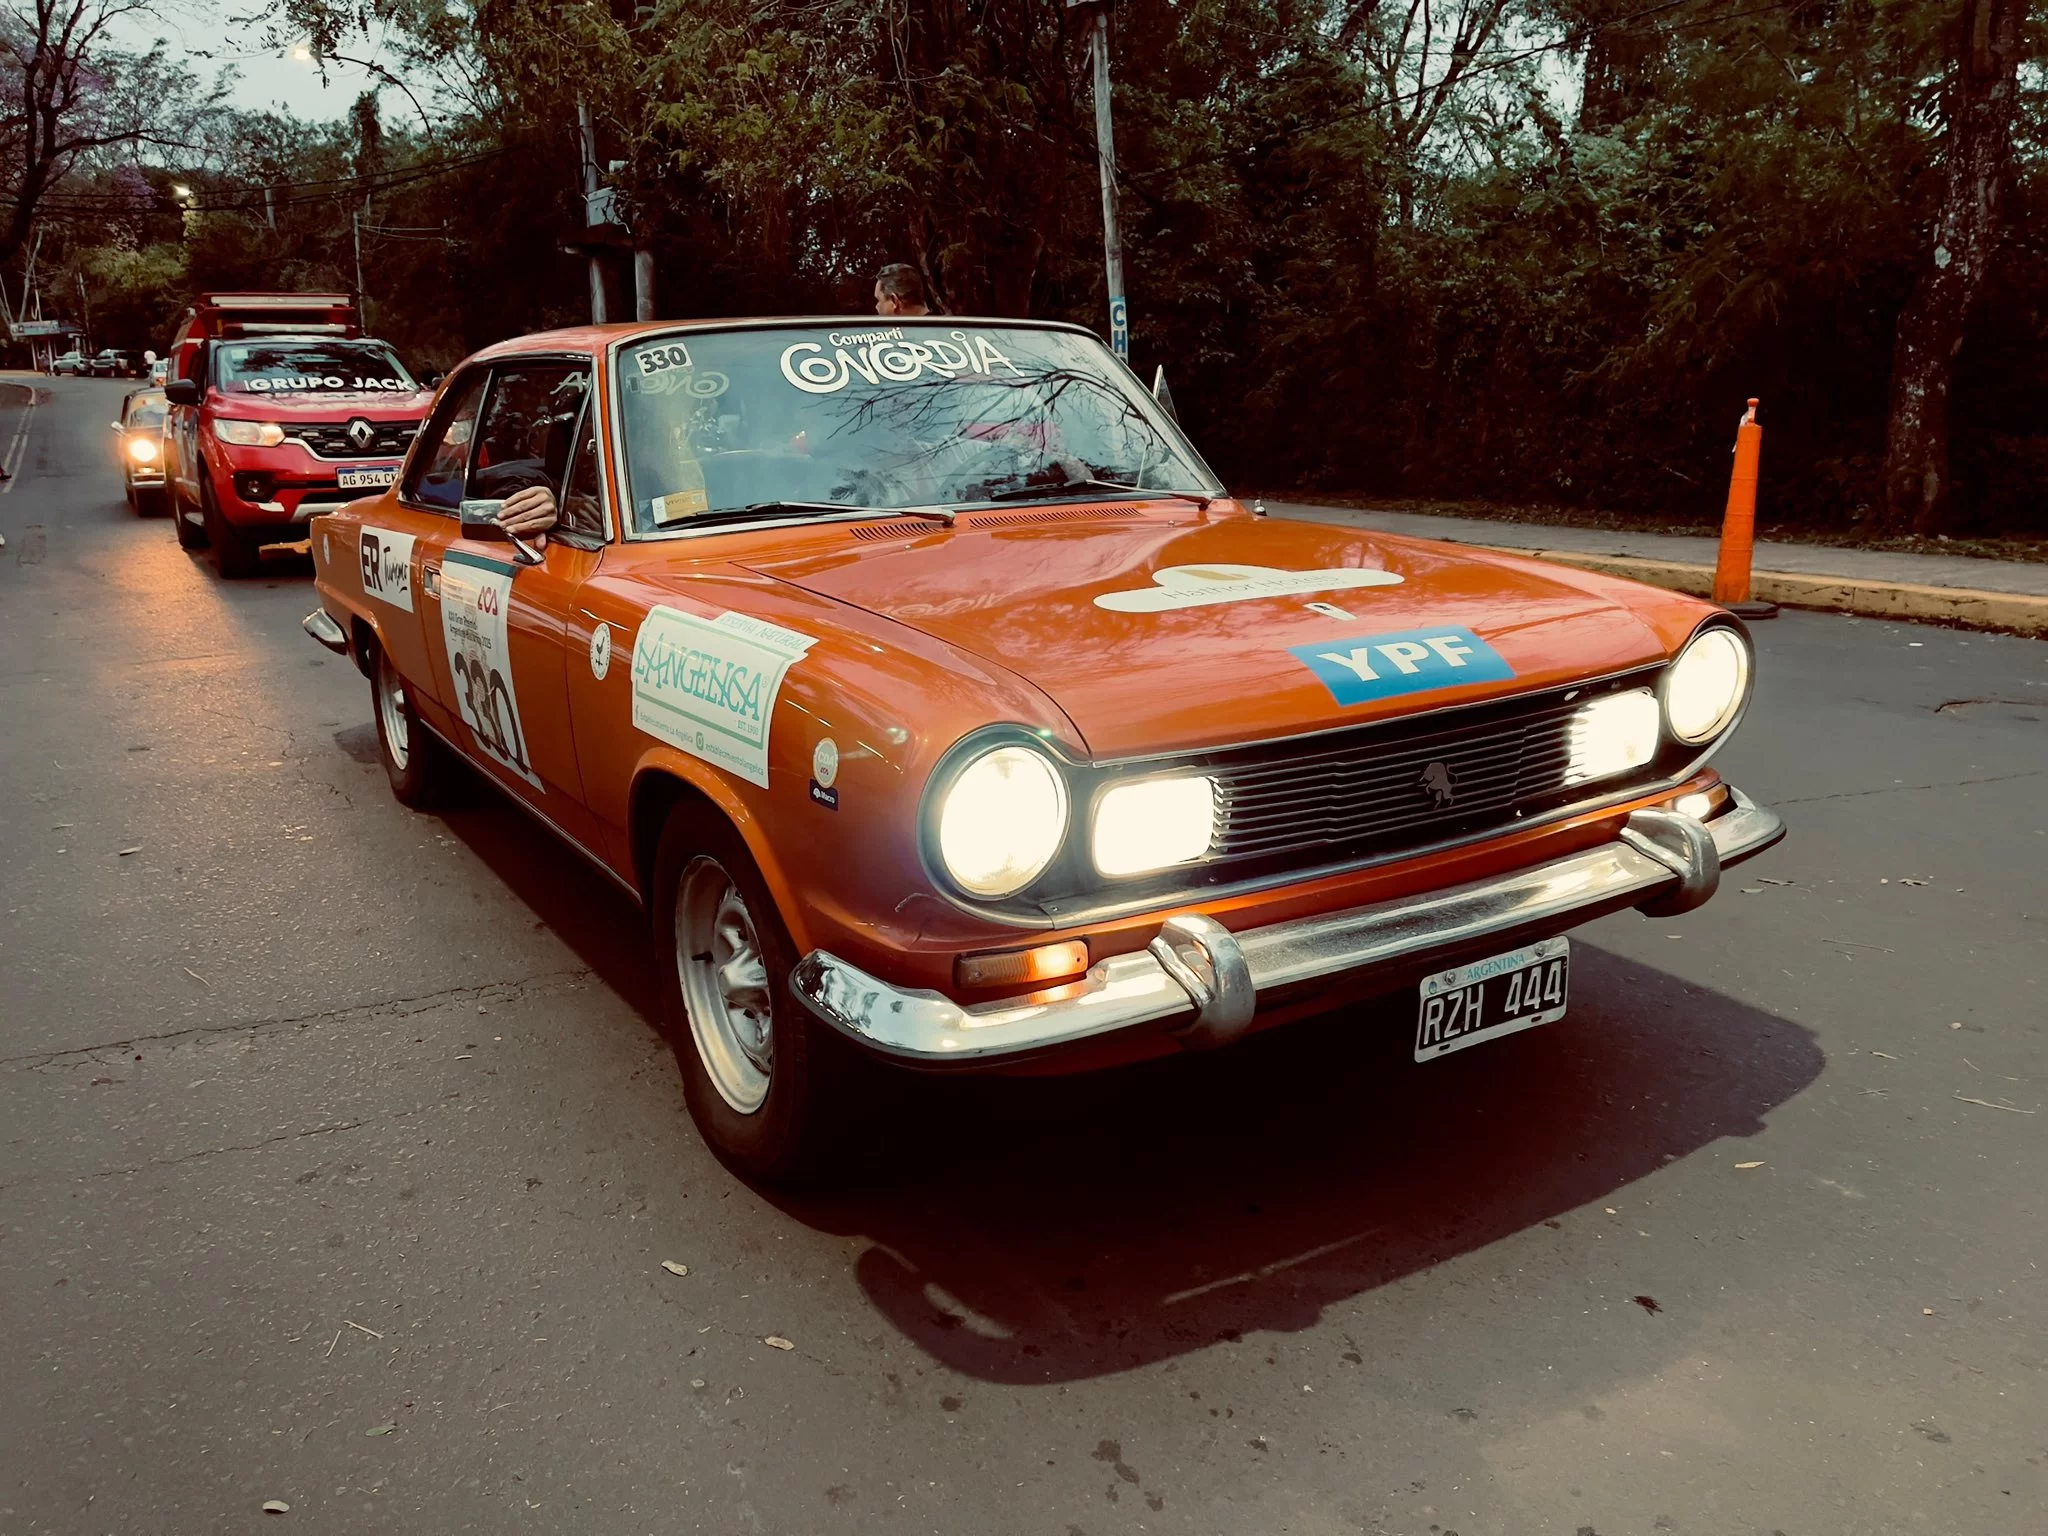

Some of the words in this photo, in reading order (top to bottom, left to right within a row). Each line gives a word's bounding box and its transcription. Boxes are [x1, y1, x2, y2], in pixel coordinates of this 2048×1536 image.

[828, 327, 904, 348] Comparti
[639, 346, 688, 374] 330
[780, 330, 1025, 394] CONCORDIA
[249, 376, 344, 390] GRUPO
[352, 376, 413, 391] JACK
[342, 475, 356, 486] AG
[360, 474, 380, 485] 954
[361, 532, 383, 592] ER
[1316, 635, 1475, 682] YPF
[454, 651, 529, 775] 330
[1464, 954, 1527, 981] ARGENTINA
[1423, 983, 1485, 1046] RZH
[1504, 960, 1562, 1015] 444
